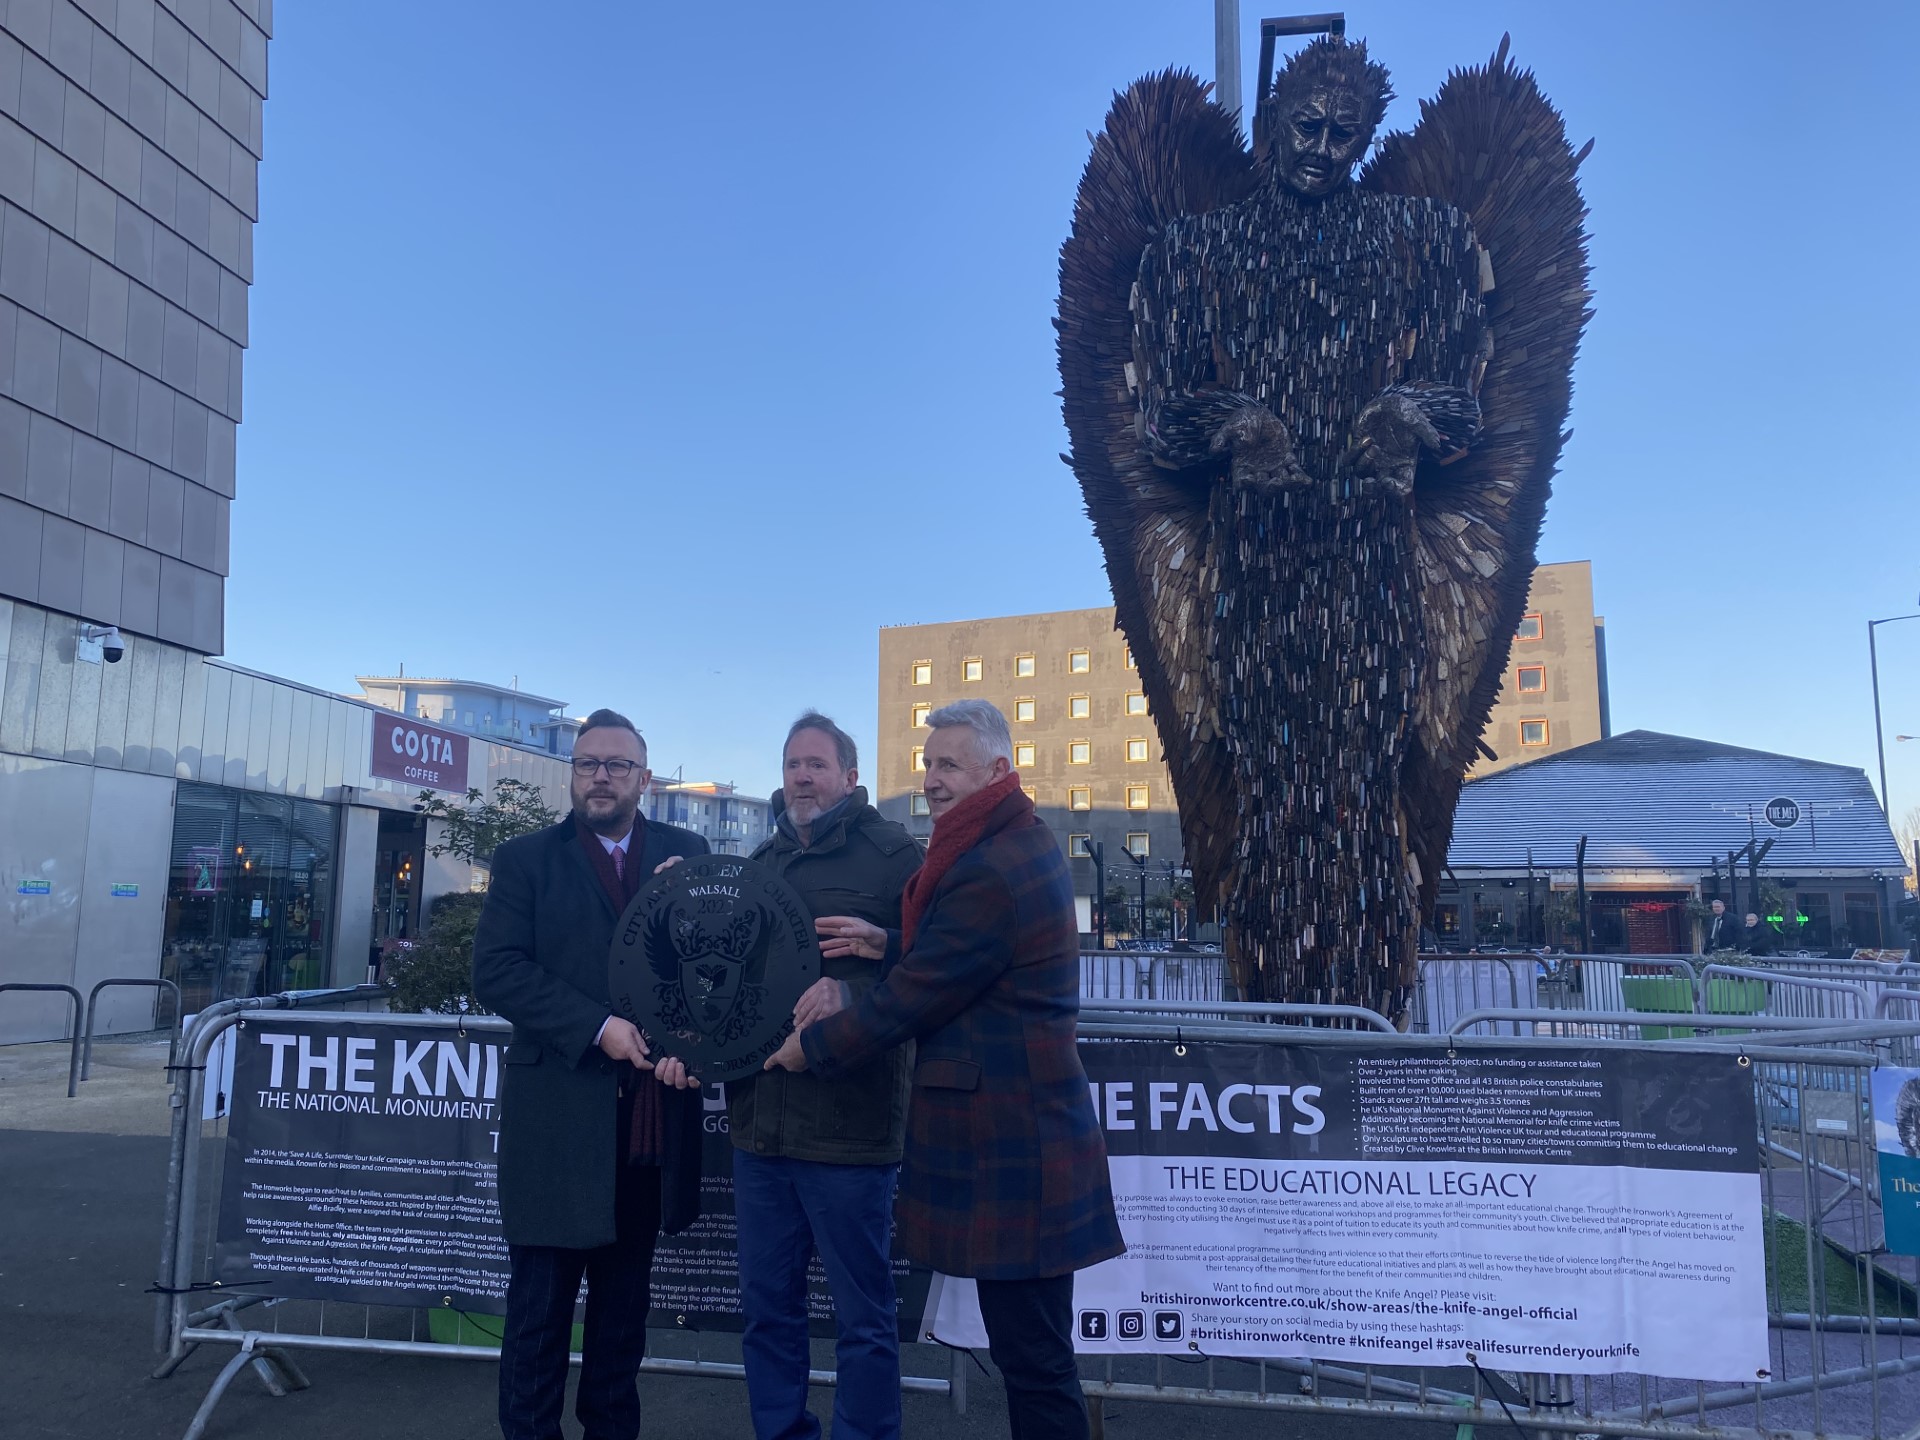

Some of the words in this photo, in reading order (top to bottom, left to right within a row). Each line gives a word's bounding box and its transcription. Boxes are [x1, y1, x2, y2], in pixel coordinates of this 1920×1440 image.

[391, 726, 453, 765] COSTA
[404, 766, 439, 783] COFFEE
[1768, 806, 1781, 819] THE
[1782, 806, 1796, 819] MET
[688, 884, 741, 899] WALSALL
[623, 906, 648, 947] CITY
[763, 880, 811, 953] CHARTER
[758, 1016, 796, 1057] VIOLEN
[260, 1033, 376, 1093] THE
[392, 1039, 509, 1100] KNI
[1358, 1058, 1369, 1066] An
[1370, 1058, 1398, 1068] entirely
[1399, 1058, 1450, 1068] philanthropic
[1452, 1058, 1481, 1068] project,
[1494, 1059, 1526, 1069] funding
[1537, 1059, 1578, 1067] assistance
[1579, 1060, 1602, 1068] taken
[1378, 1067, 1383, 1075] 2
[1384, 1069, 1404, 1077] years
[1405, 1067, 1414, 1075] in
[1415, 1067, 1427, 1075] the
[1429, 1067, 1457, 1077] making
[1359, 1077, 1391, 1085] Involved
[1471, 1077, 1481, 1085] all
[1482, 1077, 1492, 1085] 43
[1494, 1077, 1518, 1086] British
[1519, 1078, 1544, 1088] police
[1545, 1079, 1603, 1088] constabularies
[1359, 1086, 1377, 1094] Built
[1377, 1086, 1396, 1094] from
[1397, 1086, 1405, 1094] of
[1426, 1086, 1455, 1095] 100,000
[1457, 1086, 1476, 1094] used
[1476, 1087, 1502, 1095] blades
[1504, 1087, 1539, 1095] removed
[1540, 1088, 1560, 1096] from
[1561, 1088, 1574, 1097] UK
[1575, 1089, 1602, 1097] streets
[257, 1091, 290, 1110] THE
[295, 1093, 380, 1115] NATIONAL
[385, 1098, 495, 1120] MONUMENT
[1149, 1082, 1326, 1135] FACTS
[1360, 1096, 1386, 1104] Stands
[1431, 1096, 1443, 1104] tall
[1444, 1096, 1459, 1104] and
[1460, 1096, 1489, 1106] weighs
[1490, 1097, 1501, 1105] 3.5
[1502, 1097, 1531, 1105] tonnes
[1423, 1106, 1464, 1114] Monument
[1466, 1106, 1496, 1116] Against
[1497, 1107, 1531, 1115] Violence
[1549, 1109, 1593, 1119] Aggression
[1361, 1115, 1408, 1125] Additionally
[1409, 1115, 1447, 1125] becoming
[1448, 1116, 1460, 1124] the
[1462, 1116, 1495, 1124] National
[1496, 1117, 1534, 1125] Memorial
[1535, 1117, 1546, 1125] for
[1548, 1118, 1568, 1126] knife
[1569, 1118, 1592, 1126] crime
[1593, 1119, 1621, 1127] victims
[1362, 1125, 1376, 1133] The
[1395, 1125, 1410, 1133] first
[1411, 1125, 1459, 1135] independent
[1460, 1126, 1477, 1134] Anti
[1478, 1126, 1511, 1134] Violence
[1512, 1127, 1525, 1135] UK
[1526, 1127, 1543, 1135] tour
[1544, 1127, 1559, 1135] and
[1561, 1128, 1609, 1137] educational
[1609, 1131, 1657, 1141] programme
[1395, 1145, 1405, 1155] by
[1406, 1145, 1425, 1153] Clive
[1426, 1145, 1456, 1153] Knowles
[1457, 1145, 1466, 1153] at
[1467, 1145, 1481, 1153] the
[1482, 1146, 1507, 1154] British
[1508, 1147, 1544, 1155] Ironwork
[1545, 1148, 1572, 1156] Centre
[1163, 1166, 1215, 1190] THE
[1224, 1167, 1420, 1195] EDUCATIONAL
[1429, 1171, 1537, 1198] LEGACY
[1264, 1227, 1301, 1237] negatively
[1302, 1228, 1327, 1236] affects
[1347, 1229, 1371, 1237] within
[1372, 1231, 1393, 1240] every
[1394, 1231, 1440, 1241] community.
[1212, 1282, 1238, 1292] Want
[1242, 1283, 1252, 1293] to
[1254, 1283, 1274, 1293] find
[1276, 1283, 1292, 1294] out
[1295, 1286, 1320, 1295] more
[1322, 1285, 1352, 1297] about
[1355, 1287, 1373, 1298] the
[1374, 1288, 1401, 1298] Knife
[1403, 1288, 1438, 1302] Angel?
[1440, 1289, 1470, 1300] Please
[1472, 1290, 1497, 1301] visit:
[1140, 1291, 1577, 1320] britishironworkcentre.co.uk/show-areas/the-knife-angel-official
[1191, 1312, 1218, 1323] Share
[1224, 1316, 1242, 1326] your
[1244, 1315, 1268, 1327] story
[1286, 1316, 1311, 1326] social
[1313, 1317, 1344, 1328] media
[1346, 1319, 1358, 1332] by
[1361, 1321, 1388, 1334] using
[1390, 1322, 1418, 1332] these
[1420, 1322, 1464, 1334] hashtags:
[1190, 1327, 1345, 1347] #britishironworkcentre
[1349, 1334, 1433, 1353] #knifeangel
[1436, 1337, 1640, 1360] #savealifesurrenderyourknife
